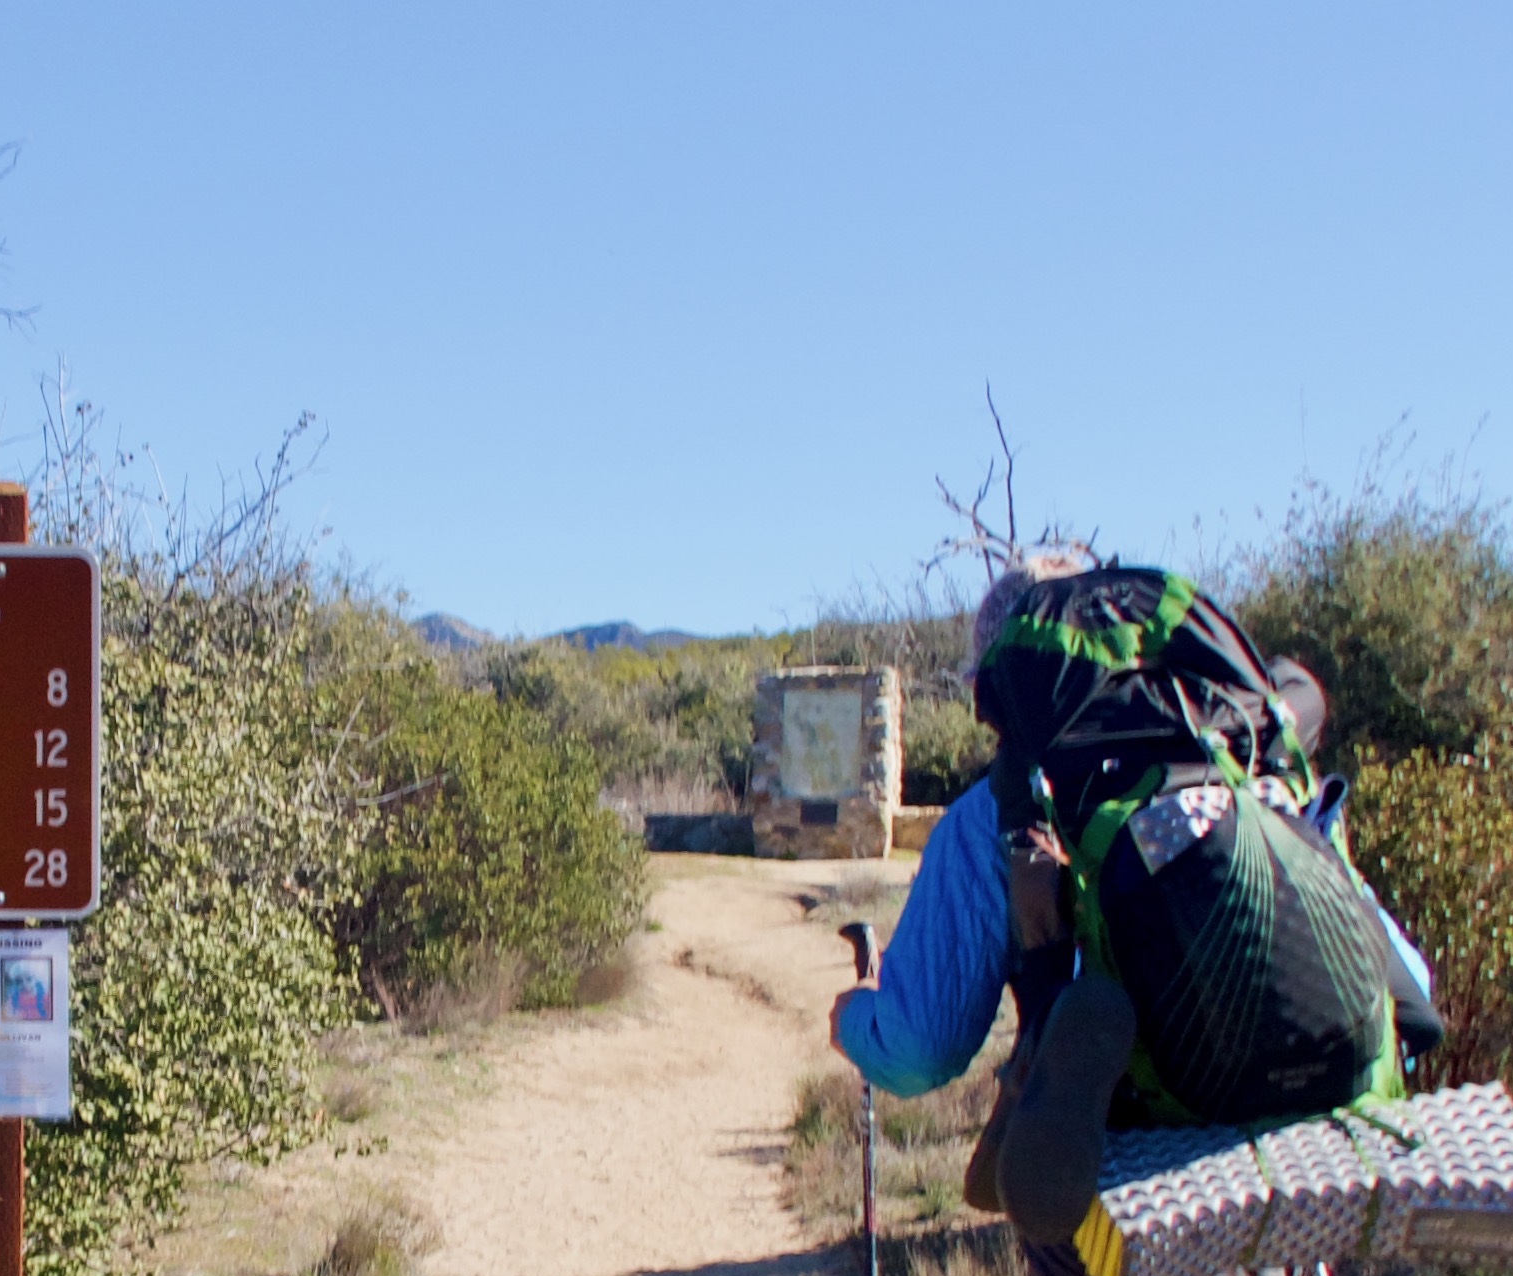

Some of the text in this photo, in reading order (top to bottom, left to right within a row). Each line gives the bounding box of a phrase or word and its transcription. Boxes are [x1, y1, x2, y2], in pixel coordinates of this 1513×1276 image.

[46, 668, 69, 707] 8
[34, 729, 69, 768] 12
[34, 789, 69, 828] 15
[23, 849, 69, 888] 28
